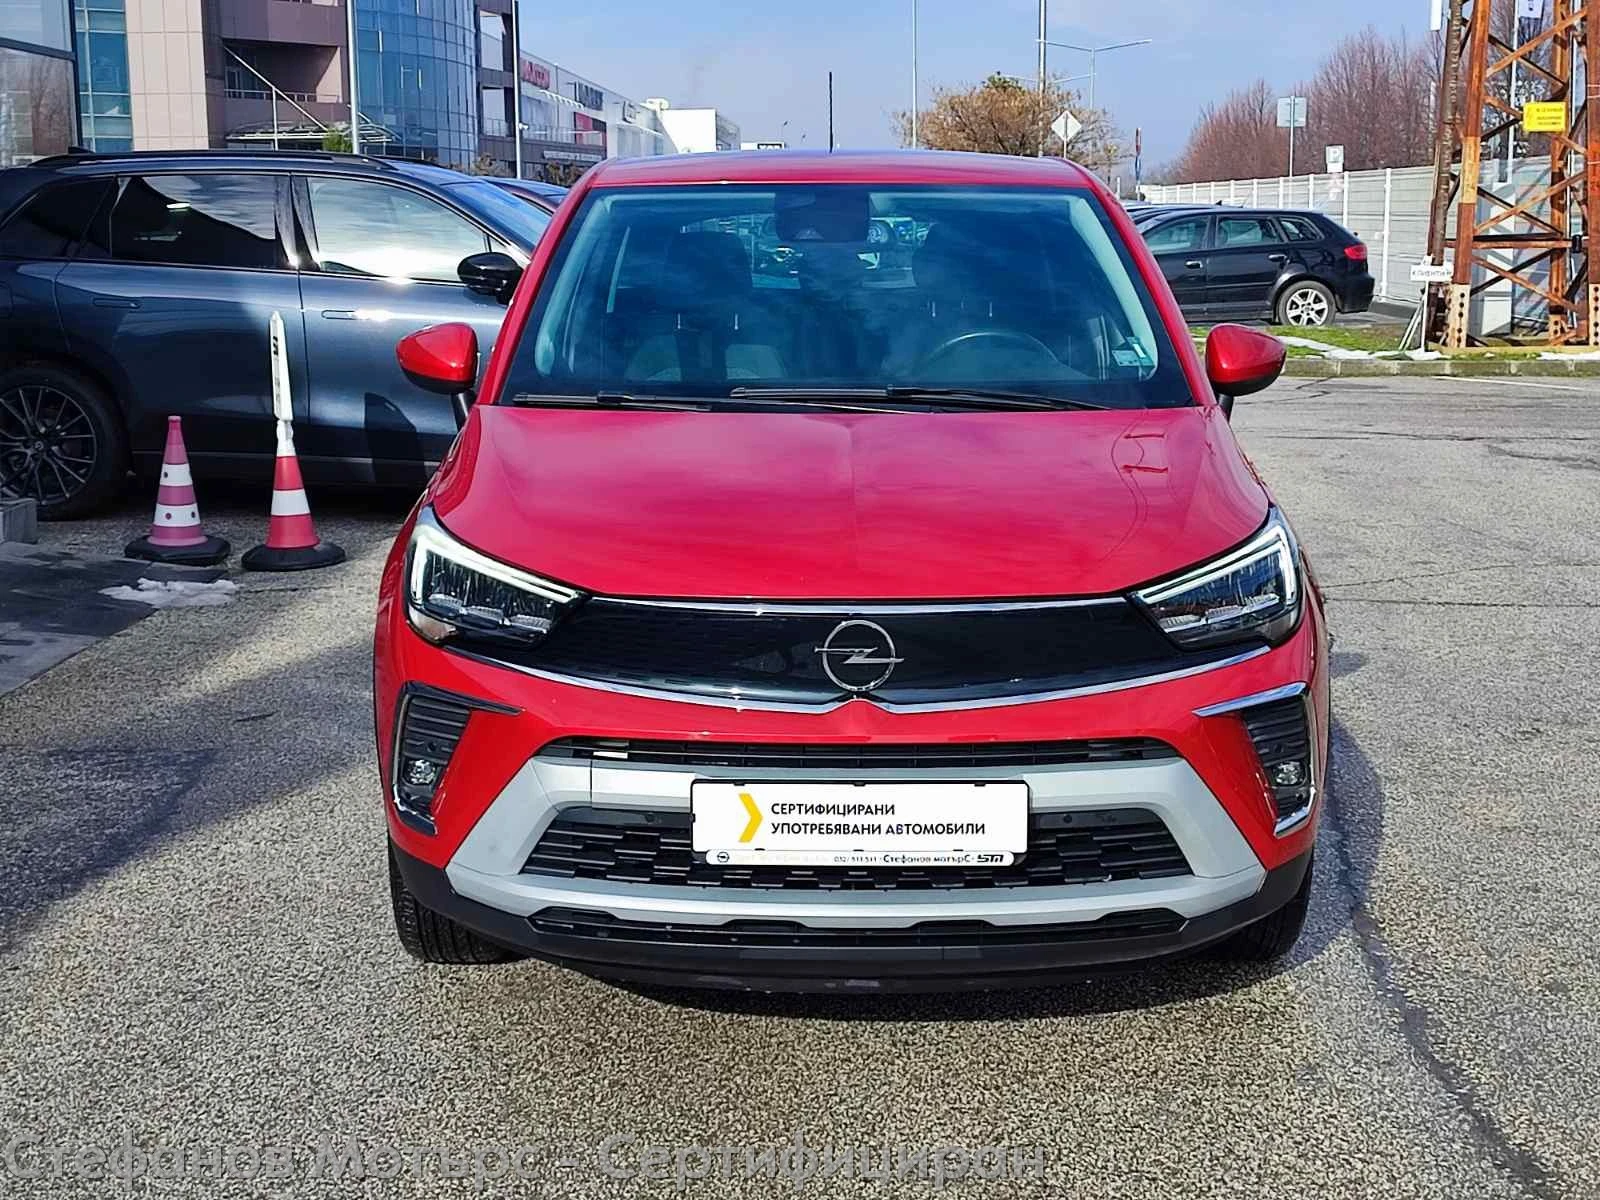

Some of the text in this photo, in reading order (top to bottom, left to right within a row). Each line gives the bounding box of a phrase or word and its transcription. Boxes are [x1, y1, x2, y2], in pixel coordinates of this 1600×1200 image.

[771, 803, 895, 816] СЕРТИФИЦИРАНИ
[771, 823, 985, 835] УПОТРЕБЯВАНИ АВТОМОБИЛИ
